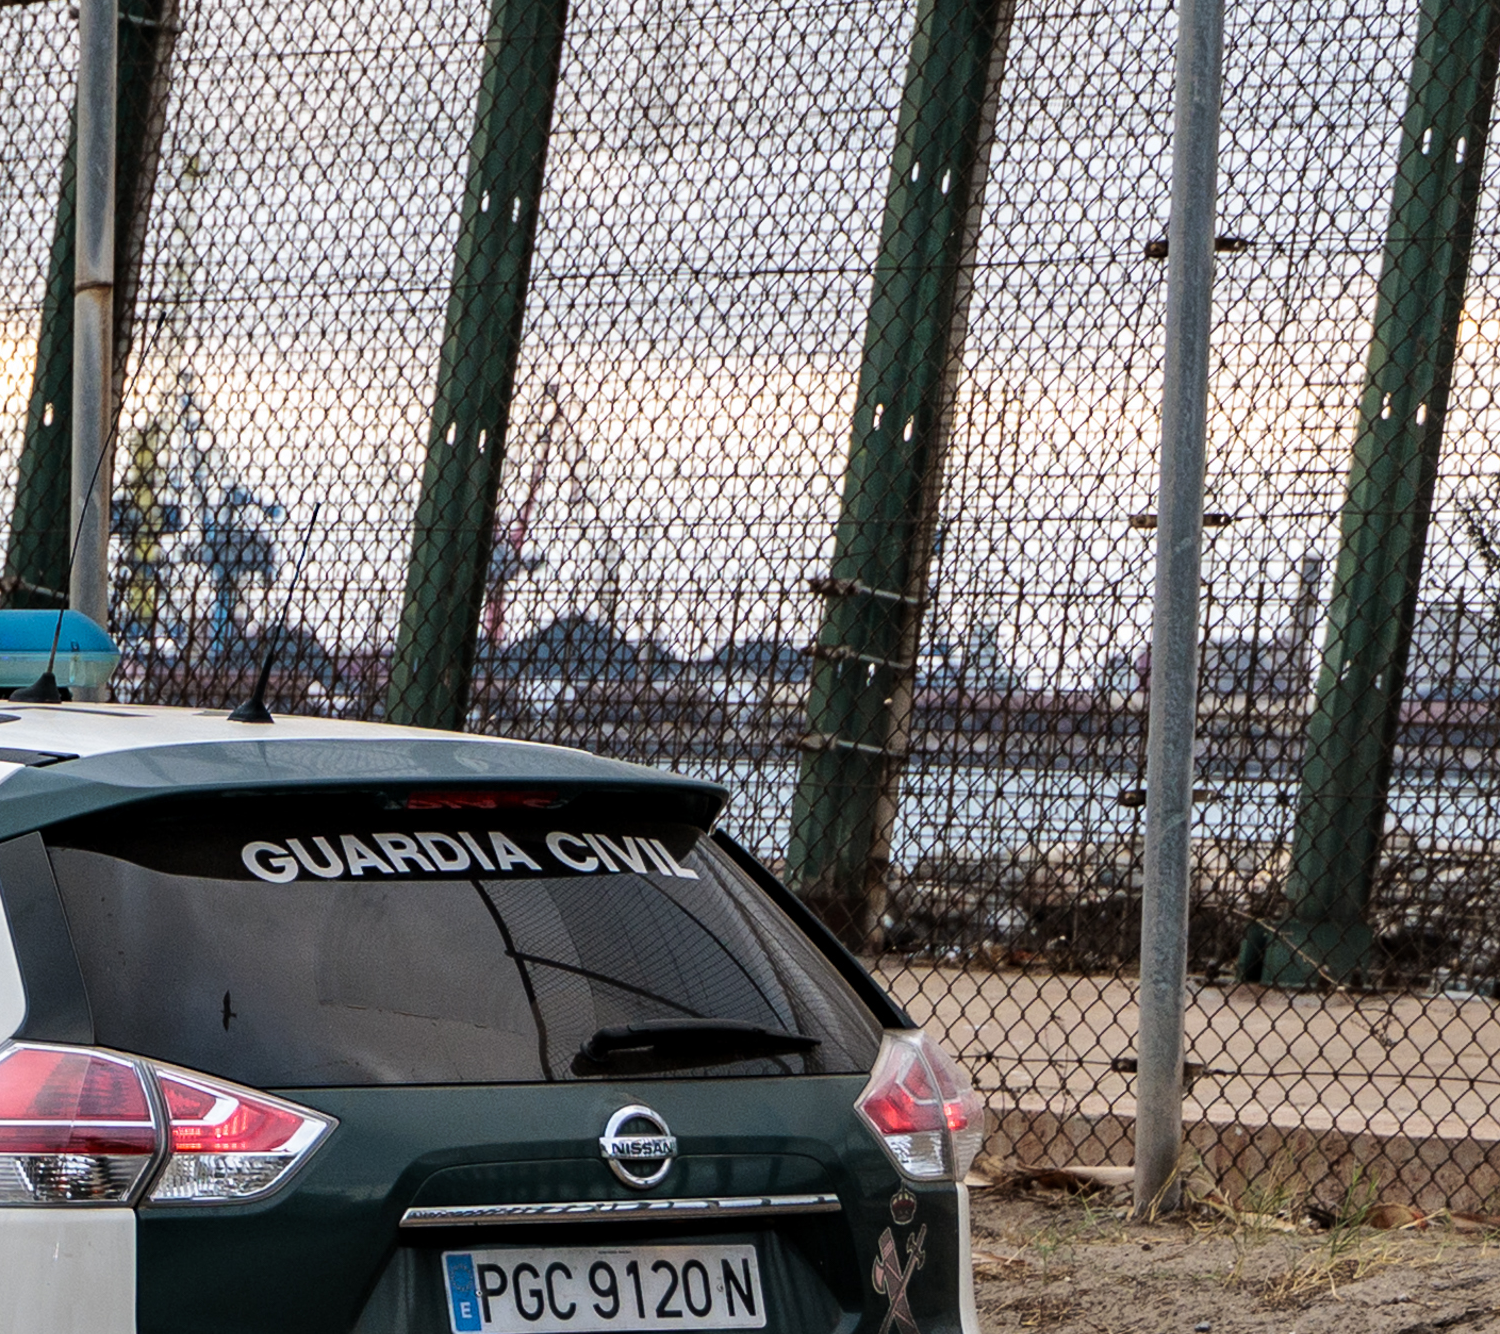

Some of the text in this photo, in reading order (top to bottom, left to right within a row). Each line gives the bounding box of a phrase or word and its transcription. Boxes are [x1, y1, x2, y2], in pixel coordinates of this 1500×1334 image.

[240, 831, 700, 883] GUARDIA CIVIL
[611, 1141, 673, 1155] NISSAN
[477, 1258, 757, 1323] PGC 9120 N
[459, 1301, 473, 1318] E
